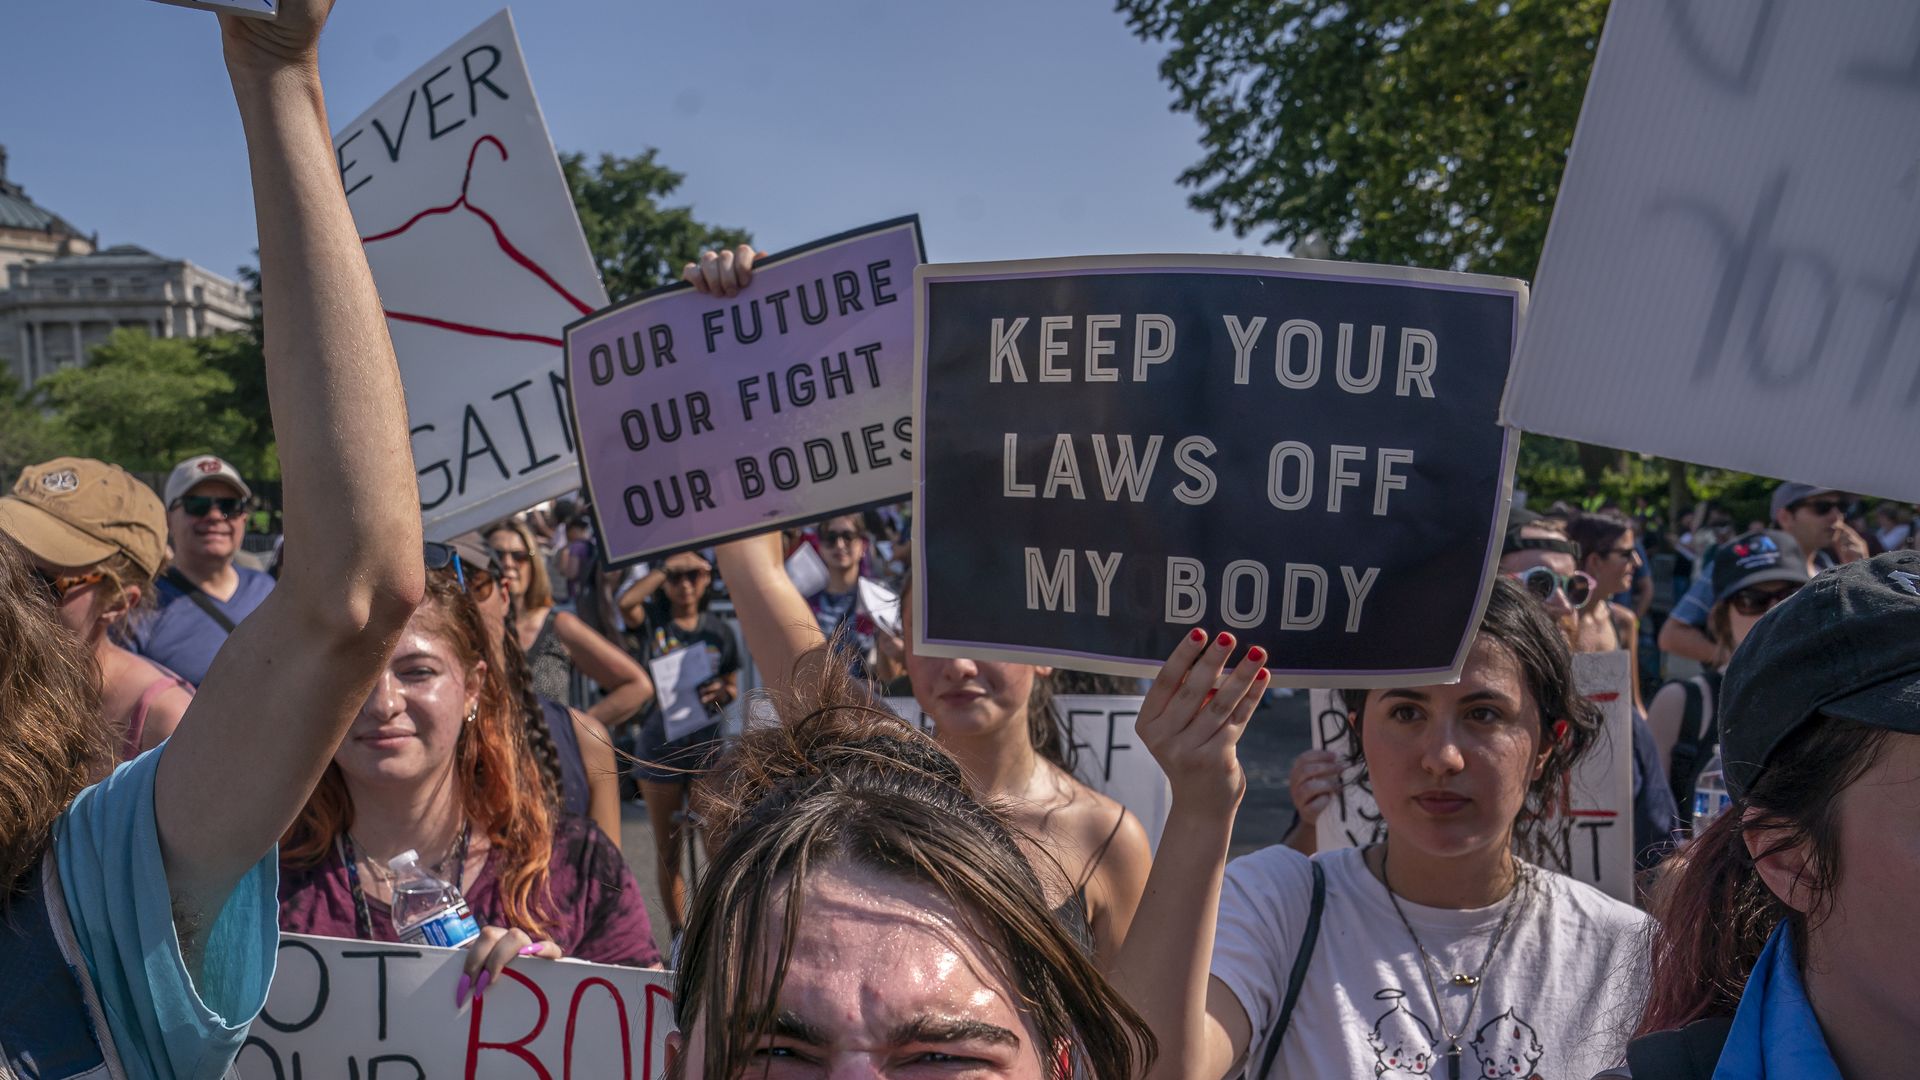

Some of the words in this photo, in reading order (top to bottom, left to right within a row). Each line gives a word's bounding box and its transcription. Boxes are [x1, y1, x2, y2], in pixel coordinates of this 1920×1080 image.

[589, 324, 677, 386] OUR
[702, 259, 898, 353] FUTURE
[990, 314, 1175, 383] KEEP
[1223, 315, 1438, 398] YOUR
[621, 391, 715, 452] OUR
[738, 342, 882, 422] FIGHT
[623, 469, 717, 527] OUR
[735, 416, 912, 500] BODIES
[1003, 433, 1218, 505] LAWS
[1267, 440, 1413, 516] OFF
[1024, 547, 1123, 616] MY
[1165, 556, 1380, 632] BODY
